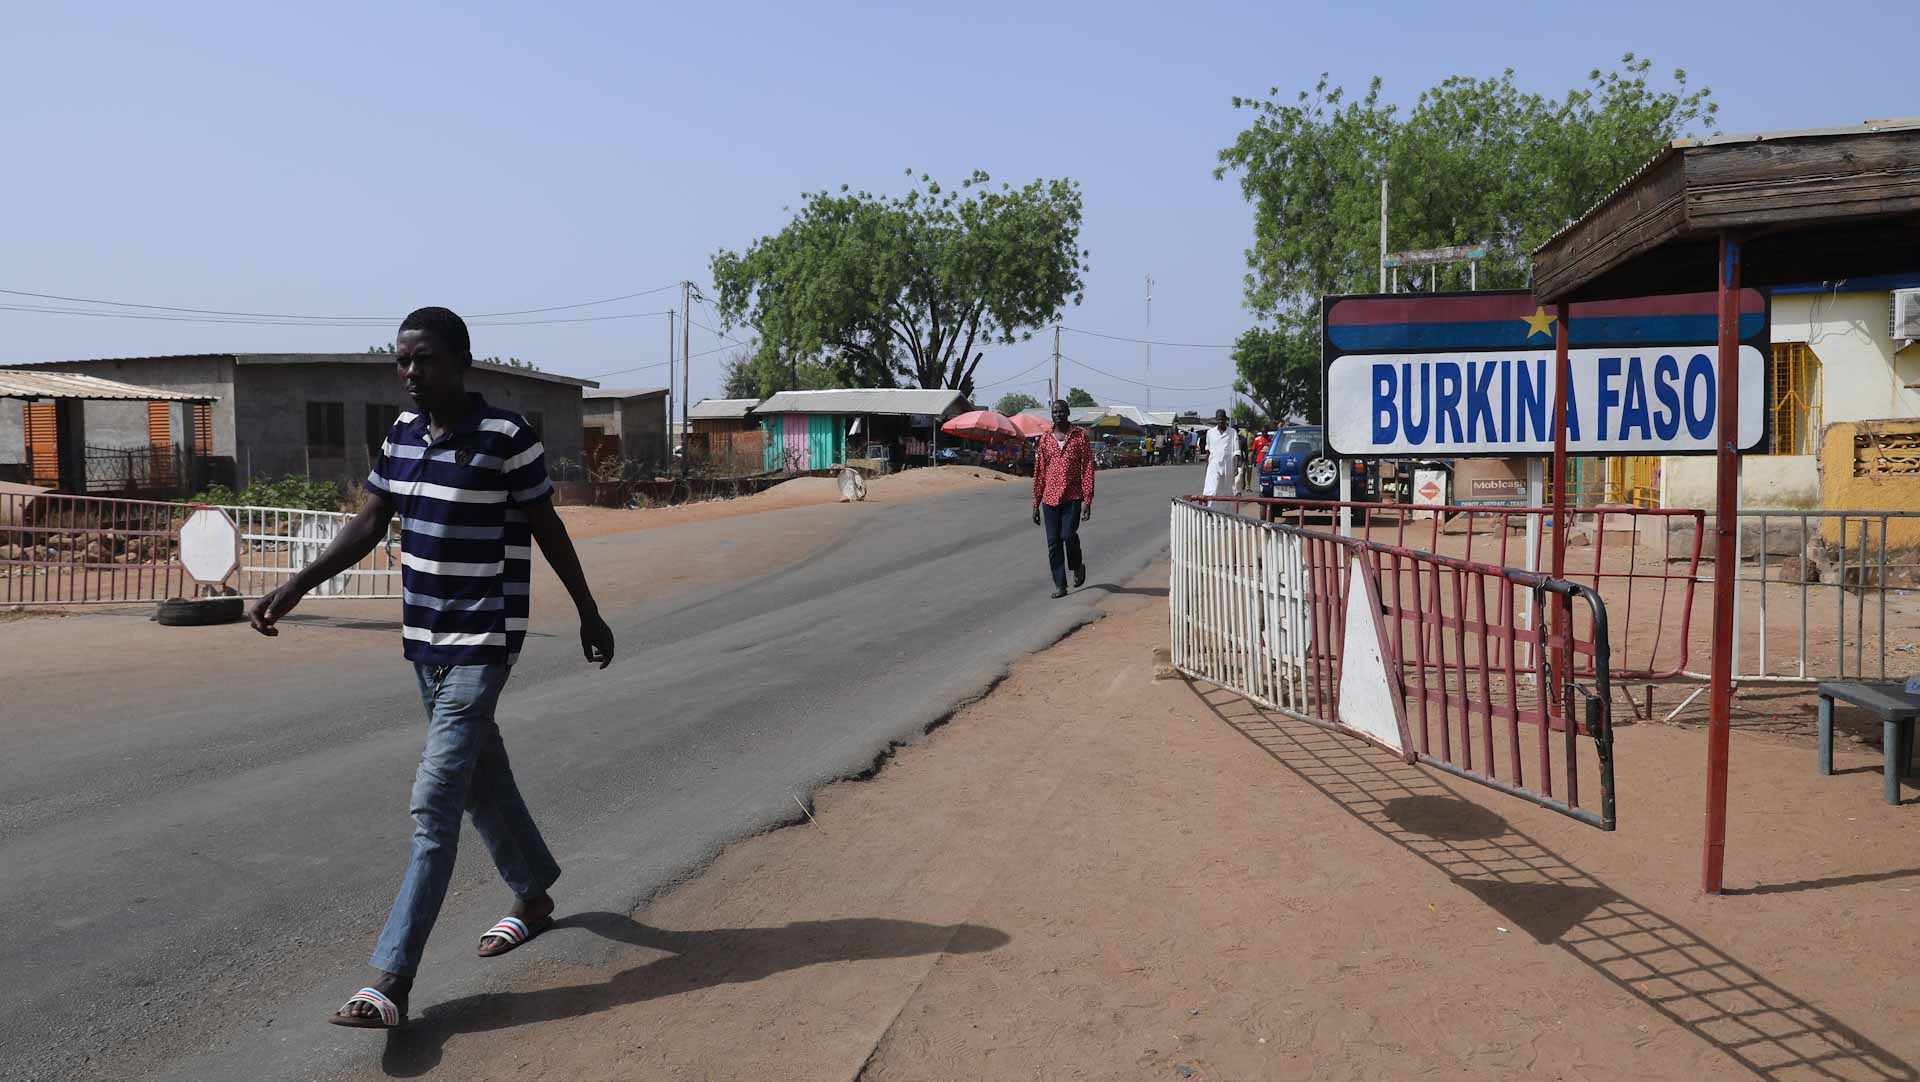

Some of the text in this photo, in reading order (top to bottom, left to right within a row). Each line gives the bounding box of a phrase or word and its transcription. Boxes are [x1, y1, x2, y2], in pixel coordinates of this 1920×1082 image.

[1372, 353, 1716, 445] BURKINA FASO
[1473, 481, 1526, 489] Mobicash
